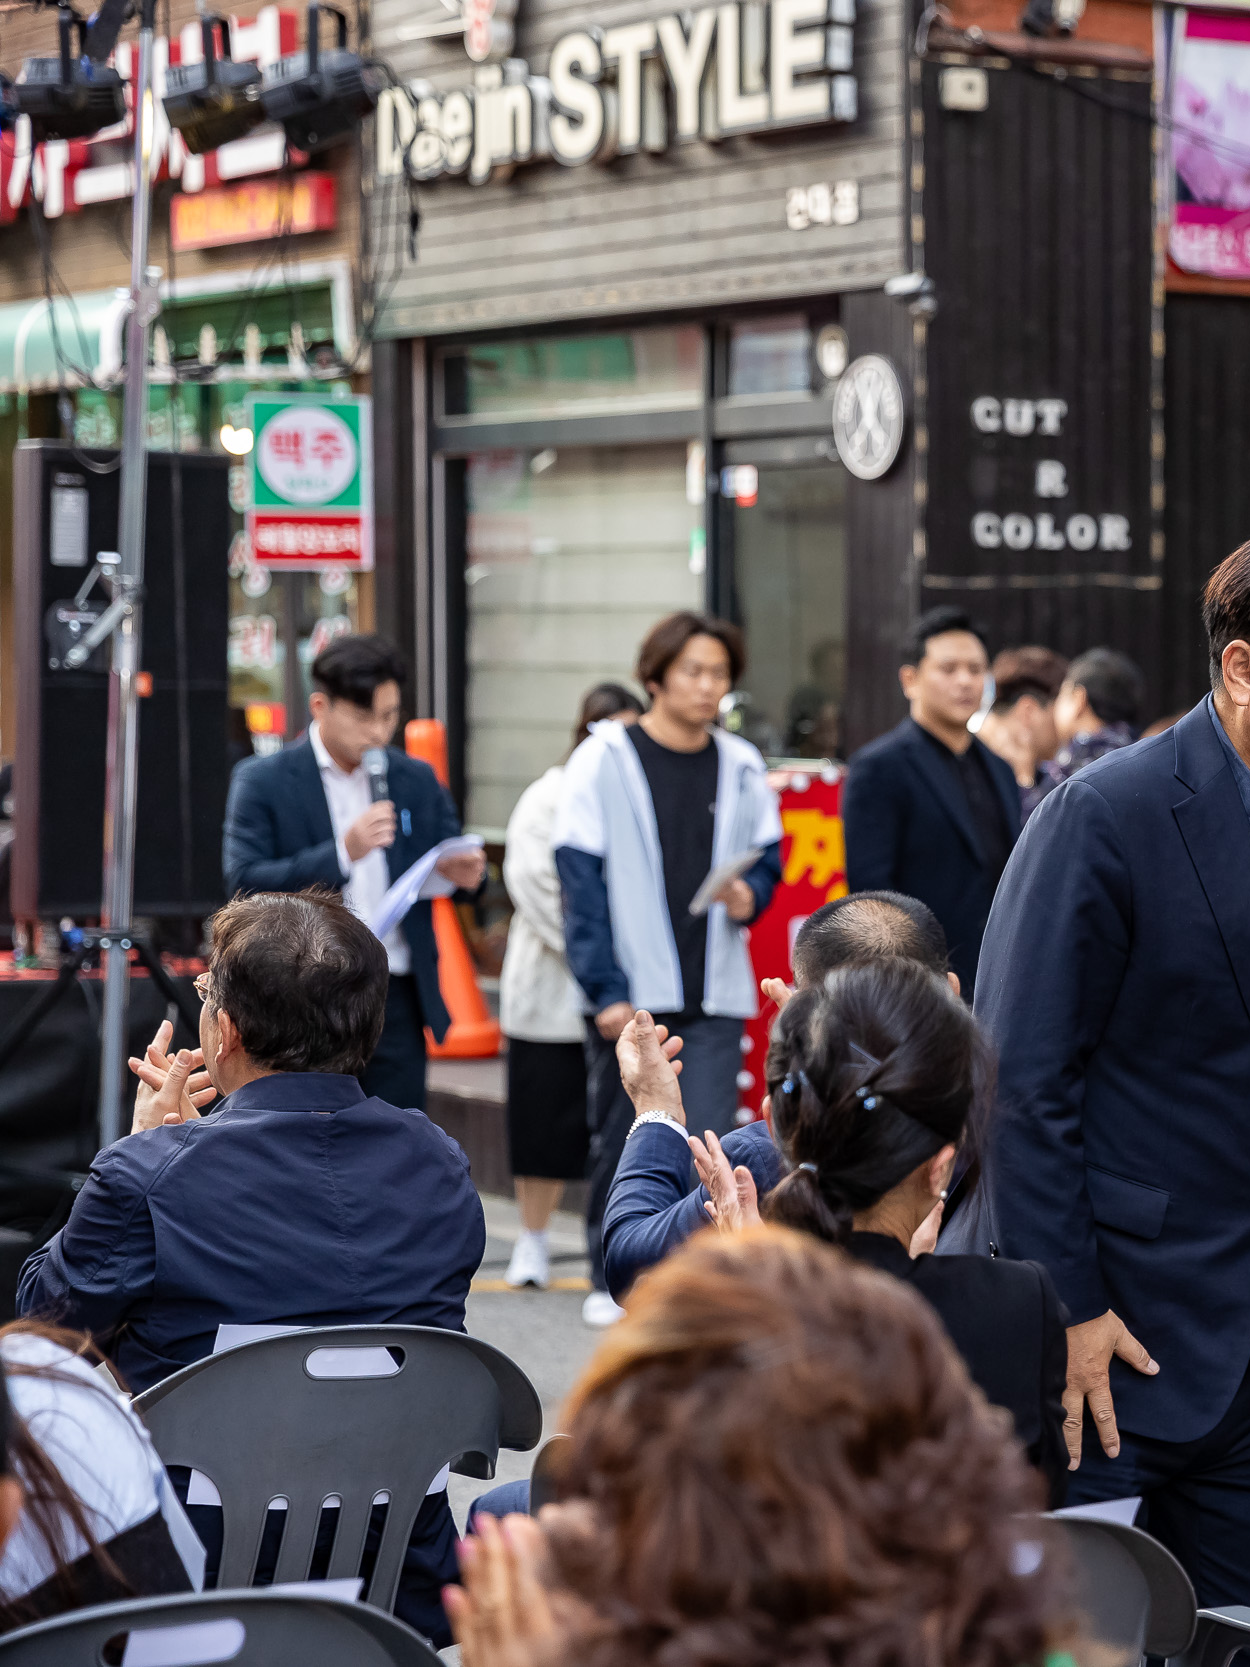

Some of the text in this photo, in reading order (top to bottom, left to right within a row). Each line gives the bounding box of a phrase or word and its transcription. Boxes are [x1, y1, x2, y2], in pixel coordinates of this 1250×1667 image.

[376, 64, 533, 184] Daejin
[551, 0, 834, 162] STYLE
[970, 395, 1069, 437] CUT
[970, 510, 1133, 552] COLOR
